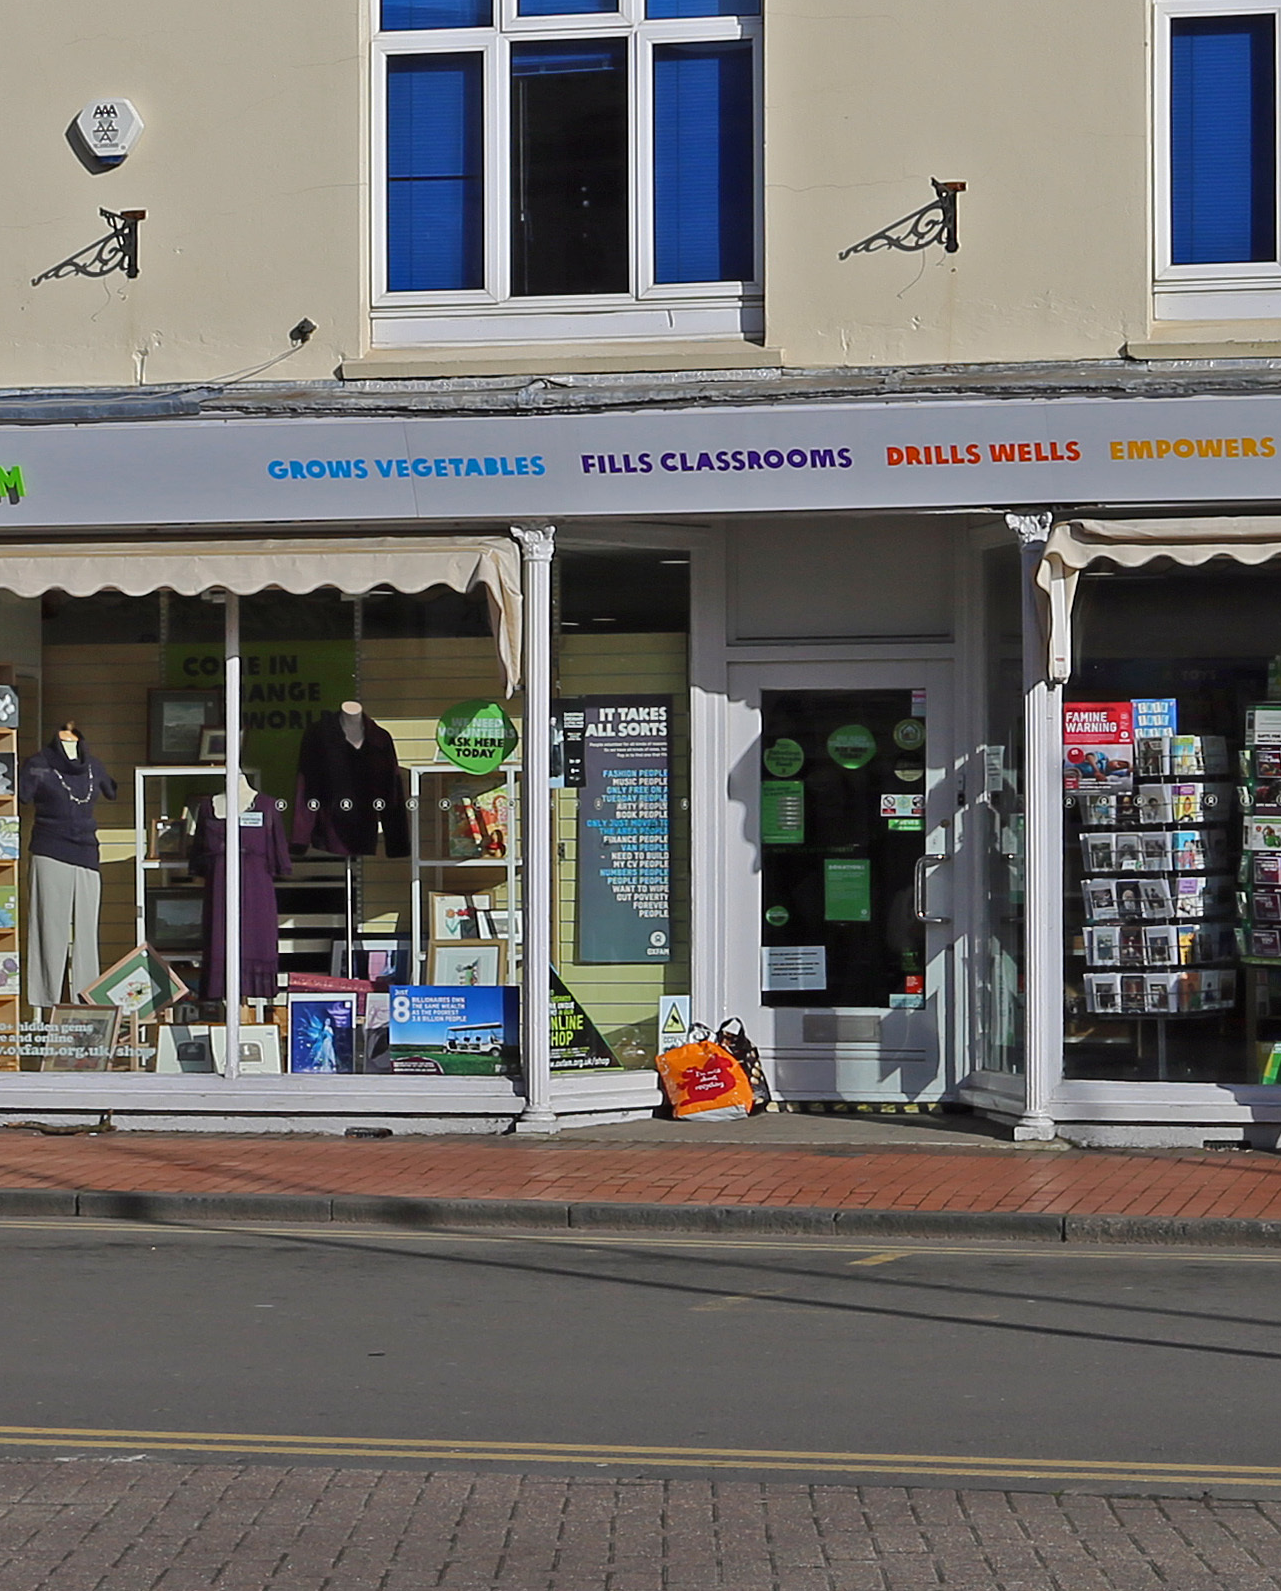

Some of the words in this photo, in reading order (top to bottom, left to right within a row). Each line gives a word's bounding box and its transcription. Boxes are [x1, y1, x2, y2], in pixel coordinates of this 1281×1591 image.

[93, 105, 118, 119] AAA
[886, 444, 981, 467] DRILLS
[990, 439, 1081, 463] WELLS
[1109, 436, 1275, 461] EMPOWERS
[580, 452, 653, 474] FILLS
[660, 446, 853, 473] CLASSROOMS
[267, 458, 368, 480] GROWS
[374, 456, 545, 479] VEGETABLES
[269, 654, 298, 675] IN
[599, 708, 616, 722] IT
[618, 707, 667, 721] TAKES
[1065, 712, 1108, 722] FAMINE
[474, 718, 505, 728] NEED
[1065, 722, 1118, 733] WARNING
[438, 727, 516, 739] VOLUNTEERS
[585, 724, 616, 737] ALL
[618, 722, 668, 737] SORTS
[448, 737, 471, 748] ASK
[475, 738, 505, 748] HERE
[455, 748, 496, 758] TODAY
[602, 770, 638, 778] FASHION
[639, 770, 668, 778] PEOPLE
[612, 778, 638, 786] MUSIC
[639, 778, 668, 786] PEOPLE
[616, 811, 638, 819] BOOK
[639, 811, 668, 819] PEOPLE
[603, 836, 638, 844] FINANCE
[639, 836, 669, 844] PEOPLE
[611, 852, 633, 860] NEED
[634, 852, 645, 860] TO
[646, 852, 669, 860] BUILD
[639, 910, 669, 918] PEOPLE
[647, 948, 670, 956] OXFAM
[393, 996, 411, 1023] 8
[18, 1023, 60, 1033] hidden
[61, 1023, 94, 1034] gems
[9, 1033, 32, 1043] and
[39, 1033, 75, 1043] online
